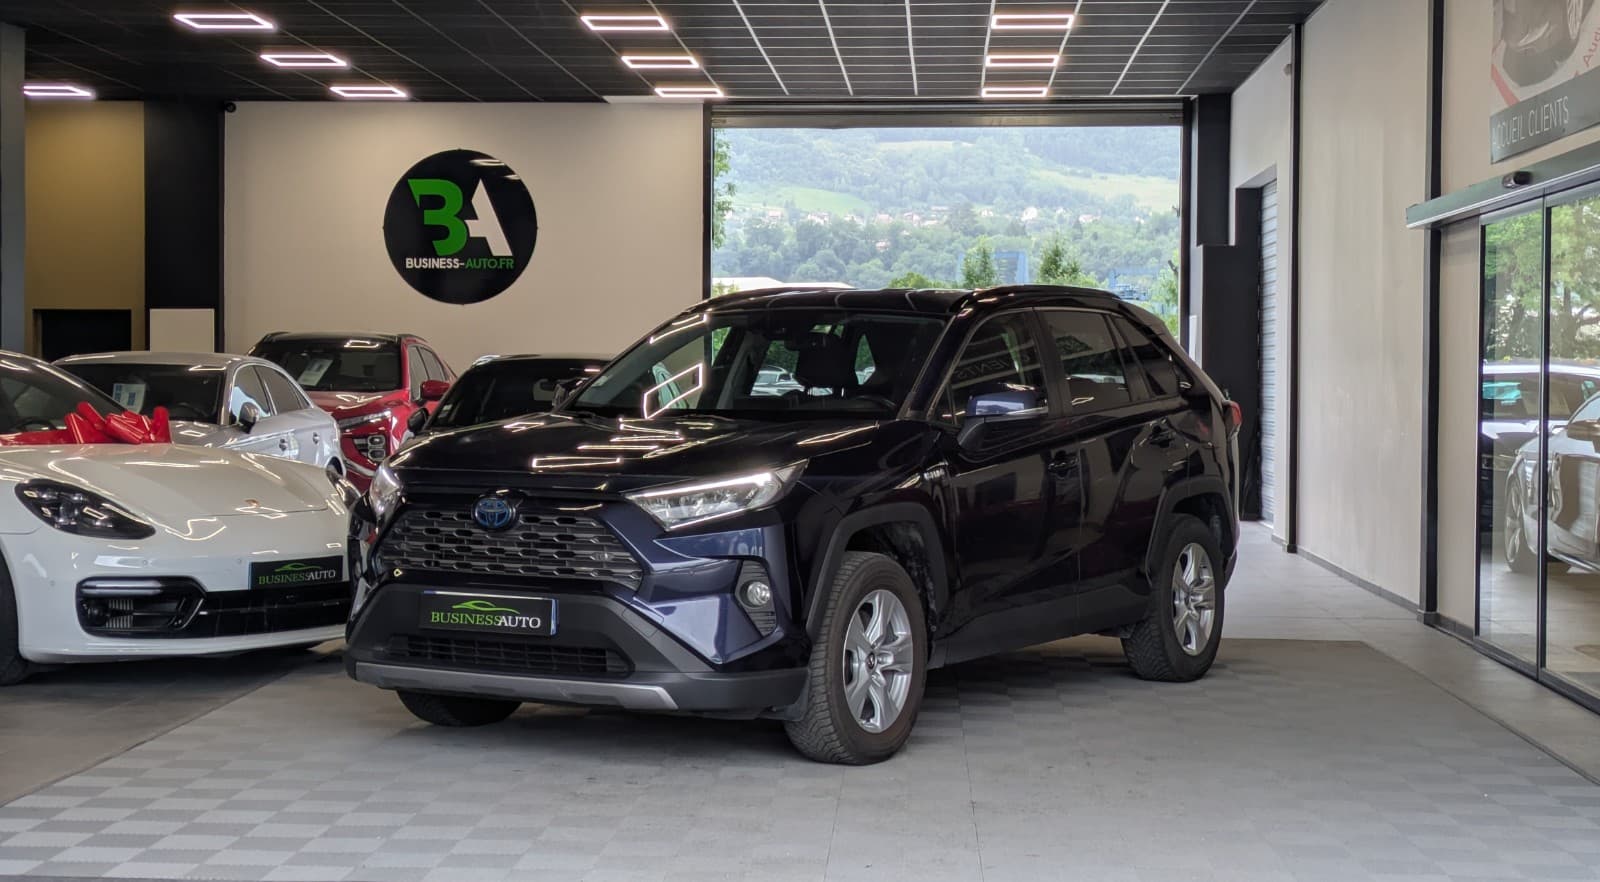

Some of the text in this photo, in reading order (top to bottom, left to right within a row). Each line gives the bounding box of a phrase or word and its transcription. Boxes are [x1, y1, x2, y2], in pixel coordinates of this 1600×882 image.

[1528, 95, 1569, 137] CLIENTS
[407, 178, 513, 257] BA
[405, 257, 514, 269] BUSINESS-AUTO.FR
[431, 611, 541, 629] BUSINESSAUTO
